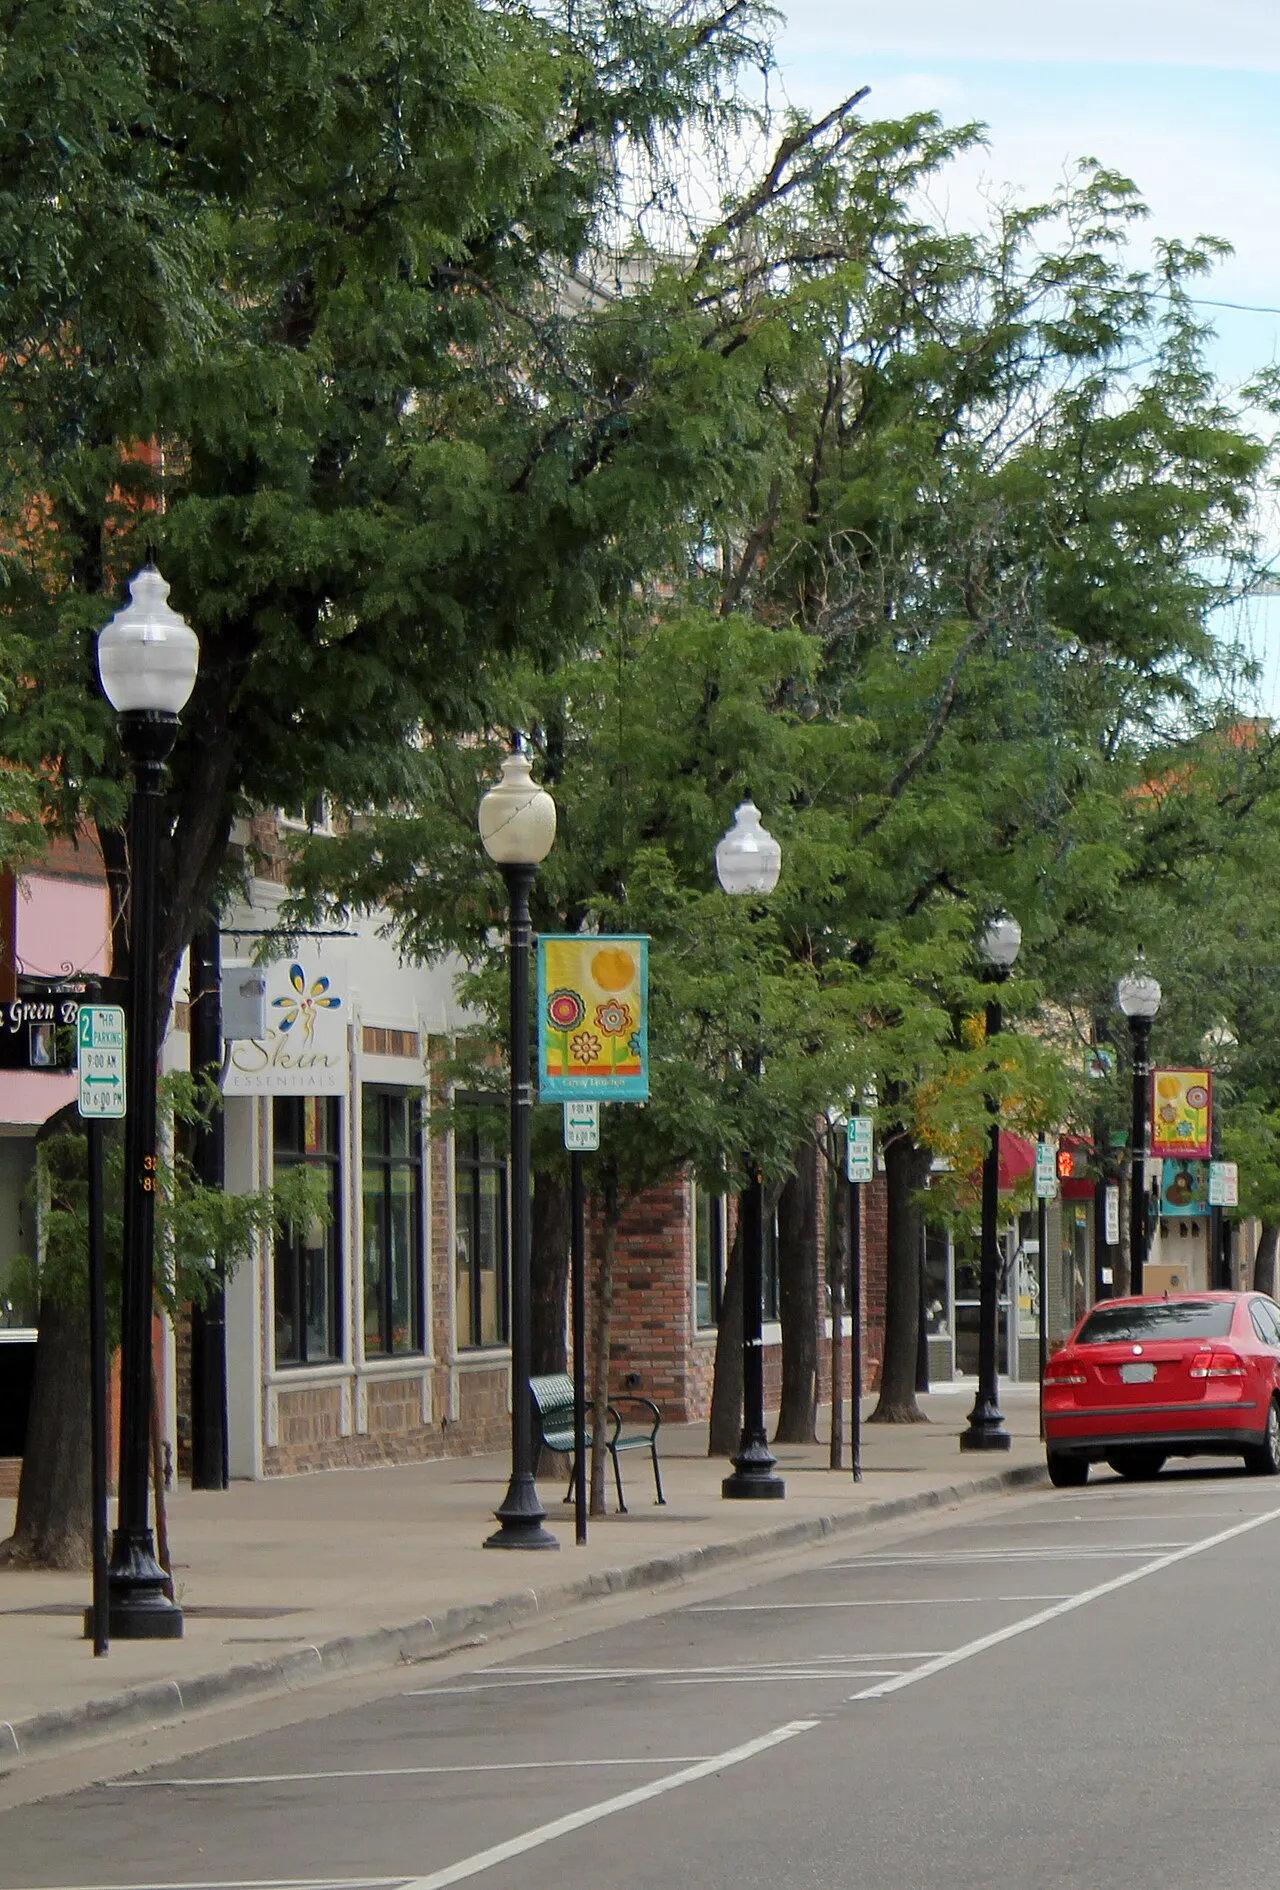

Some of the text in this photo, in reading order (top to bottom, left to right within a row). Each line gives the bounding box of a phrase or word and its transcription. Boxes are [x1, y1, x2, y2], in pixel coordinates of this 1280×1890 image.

[9, 999, 55, 1034] Green
[81, 1013, 114, 1042] 2 HR
[94, 1031, 123, 1046] PARKING
[232, 1028, 339, 1073] Skin
[87, 1055, 118, 1068] 9:00 AM
[233, 1076, 336, 1087] ESSENTIALS
[82, 1092, 123, 1106] TO 6:00 PM
